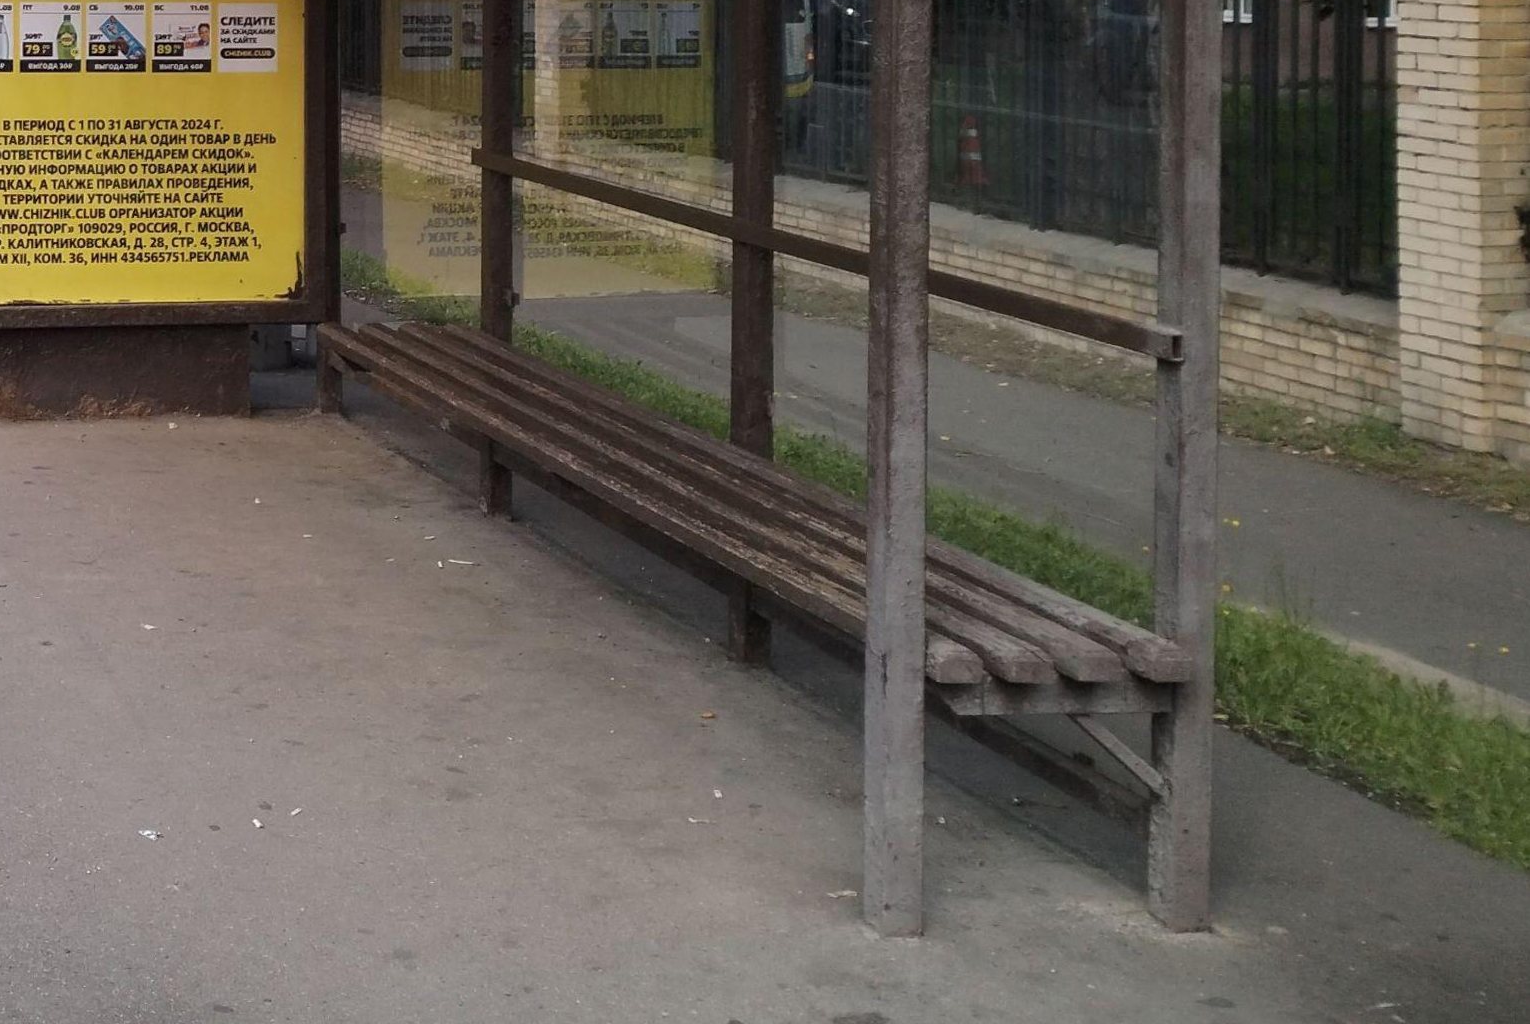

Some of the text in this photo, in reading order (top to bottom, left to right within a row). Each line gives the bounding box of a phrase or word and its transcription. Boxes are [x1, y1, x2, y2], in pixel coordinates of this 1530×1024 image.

[221, 17, 276, 27] СЛЕДИТЕ
[221, 36, 257, 44] НА САЙТЕ
[23, 44, 39, 54] 79
[91, 44, 106, 54] 59
[157, 44, 172, 54] 89
[3, 120, 224, 131] В ПЕРИОД С 1 ПО 31 АВГУСТА 2024 Г.
[75, 134, 127, 147] СКИДКА
[130, 134, 147, 146] НА
[151, 134, 187, 147] ОДИН
[190, 134, 230, 146] ТОВАР
[233, 134, 241, 146] В
[244, 134, 276, 147] ДЕНЬ
[85, 149, 92, 160] С
[96, 149, 189, 160] «КАЛЕНДАРЕМ
[192, 149, 254, 160] СКИДОК».
[29, 163, 125, 176] ИНФОРМАЦИЮ
[129, 163, 138, 175] О
[141, 163, 198, 175] ТОВАРАХ
[201, 163, 246, 176] АКЦИИ
[249, 163, 257, 175] И
[40, 178, 48, 190] А
[51, 178, 93, 190] ТАКЖЕ
[97, 178, 163, 190] ПРАВИЛАХ
[167, 178, 253, 192] ПРОВЕДЕНИЯ,
[3, 191, 223, 205] ТЕРРИТОРИИ УТОЧНЯЙТЕ НА САЙТЕ
[109, 208, 196, 219] ОРГАНИЗАТОР
[199, 208, 243, 220] АКЦИИ
[78, 222, 126, 236] 109029,
[130, 222, 181, 236] РОССИЯ,
[185, 222, 195, 233] Г.
[198, 222, 254, 236] МОСКВА,
[8, 236, 130, 250] КАЛИТНИКОВСКАЯ,
[133, 236, 147, 250] Д.
[150, 236, 168, 250] 28,
[171, 236, 198, 248] СТР.
[200, 236, 212, 250] 4,
[215, 236, 249, 248] ЭТАЖ
[252, 236, 262, 250] 1,
[34, 251, 66, 263] КОМ.
[69, 251, 88, 266] 36,
[91, 251, 117, 263] ИНН
